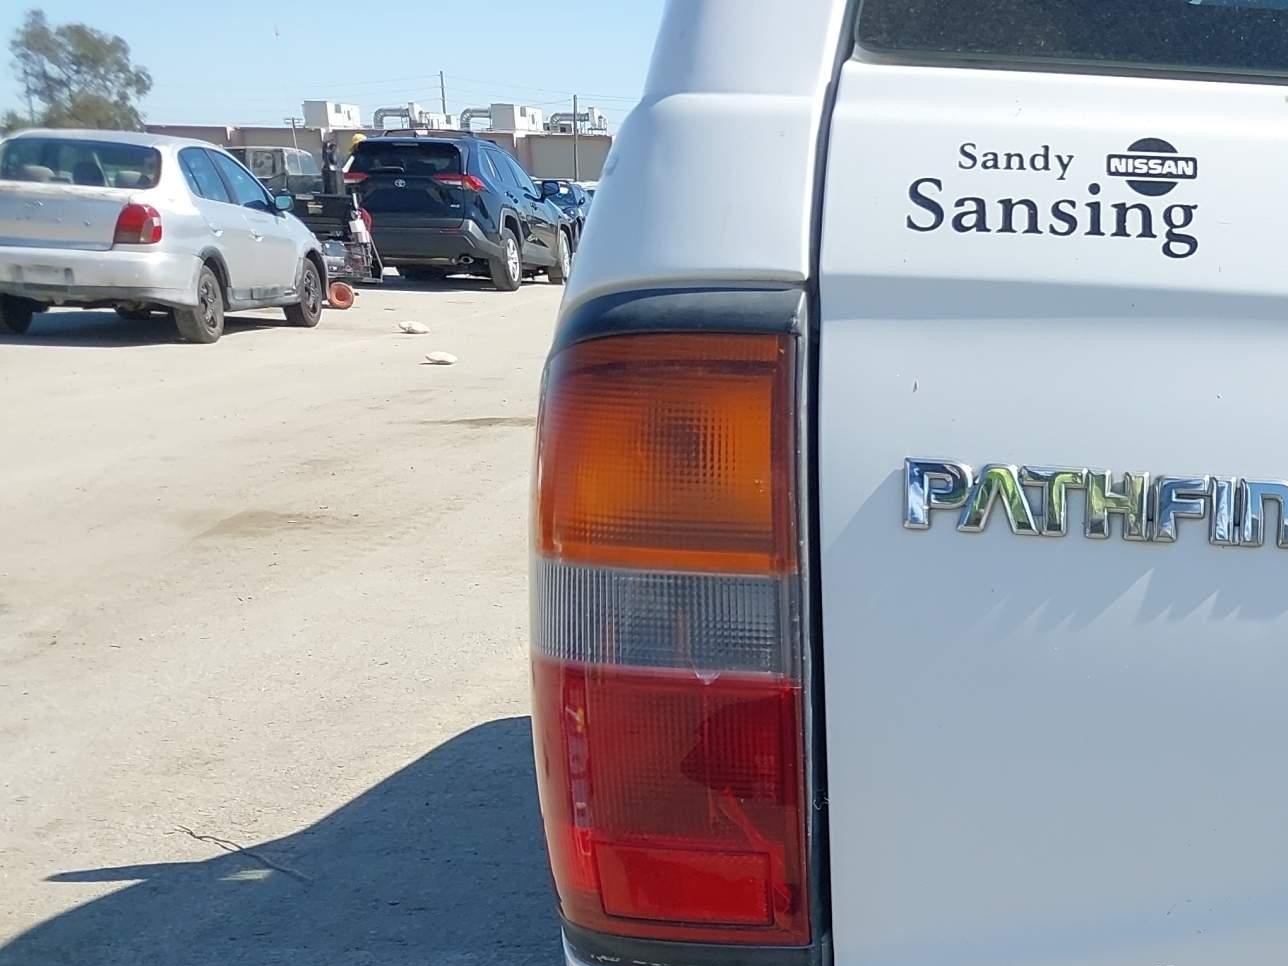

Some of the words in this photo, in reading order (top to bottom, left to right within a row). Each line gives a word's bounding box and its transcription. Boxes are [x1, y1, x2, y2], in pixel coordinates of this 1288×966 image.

[957, 142, 1075, 181] Sandy
[1108, 156, 1196, 177] NISSAN
[905, 177, 1200, 259] Sansing
